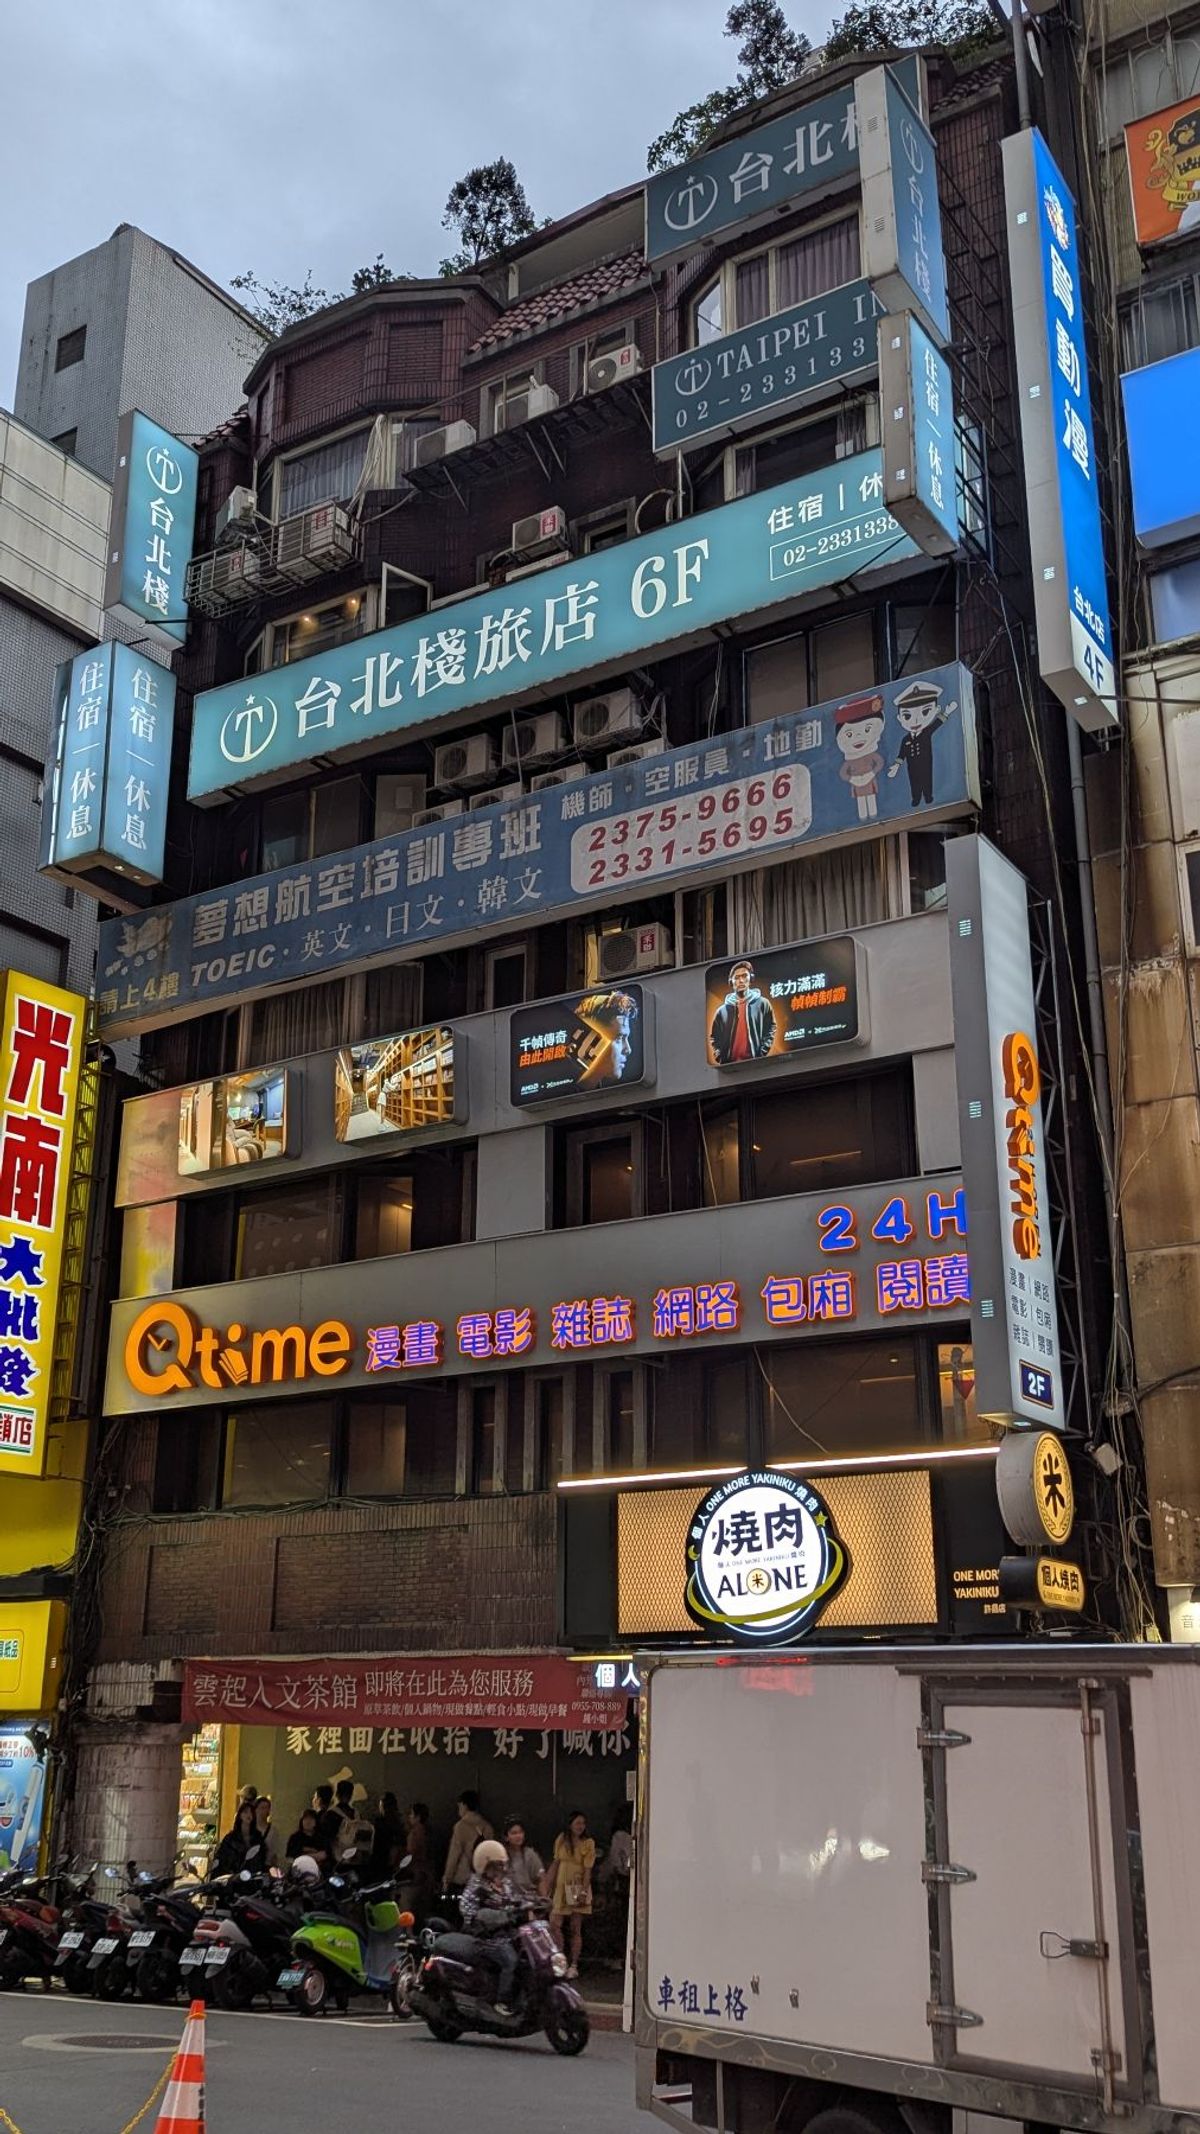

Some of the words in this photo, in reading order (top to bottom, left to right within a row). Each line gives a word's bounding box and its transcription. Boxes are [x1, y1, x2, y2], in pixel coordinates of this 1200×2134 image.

[908, 175, 932, 303] 台北棧
[717, 310, 828, 379] TAIPEI
[1050, 244, 1090, 480] 買動漫
[924, 347, 940, 417] 住宿
[928, 441, 944, 511] 休息
[768, 494, 823, 535] 住宿
[142, 497, 174, 616] 台北棧
[294, 579, 600, 739] 台北棧旅店
[629, 537, 711, 619] 6F
[1074, 586, 1105, 645] 台北店
[76, 661, 105, 732] 住宿
[1084, 645, 1104, 690] 4F
[129, 667, 159, 743] 住宿
[66, 767, 97, 840] 休息
[560, 781, 613, 821] 機師
[644, 748, 730, 797] 空服員
[763, 719, 823, 762] 地勤
[121, 774, 152, 850] 休息
[588, 772, 793, 853] 2375-9666
[588, 807, 794, 886] 2331-5695
[192, 803, 542, 948] 夢想航空培訓專班
[191, 943, 277, 987] TOEIC
[301, 922, 353, 962] 英文
[386, 891, 444, 939] 日文
[477, 866, 544, 916] 韓文
[100, 971, 180, 1015] 請上4樓
[770, 973, 826, 998] 核力滿滿
[0, 993, 75, 1233] 光南
[1002, 1031, 1041, 1261] Qtime
[0, 1235, 47, 1400] 大批發
[125, 1301, 351, 1397] Qtime
[366, 1321, 439, 1373] 漫畫
[457, 1307, 532, 1359] 電影
[552, 1296, 633, 1349] 雜誌
[653, 1282, 739, 1338] 網路
[763, 1270, 854, 1325] 包廂
[877, 1253, 969, 1313] 閱讀
[1027, 1371, 1045, 1397] 2F
[706, 1491, 725, 1511] ONE
[723, 1475, 751, 1496] MORE
[751, 1473, 797, 1491] YAKINIKU
[712, 1503, 804, 1556] 燒肉
[717, 1565, 808, 1599] ALONE
[953, 1570, 974, 1581] ONE
[976, 1569, 999, 1581] MOR
[954, 1586, 999, 1598] YAKINIKU
[1041, 1565, 1080, 1592] 個人燒肉
[192, 1674, 358, 1709] 雲起人文茶館
[364, 1669, 534, 1698] 即將在此為您服務
[595, 1662, 641, 1688] 個人
